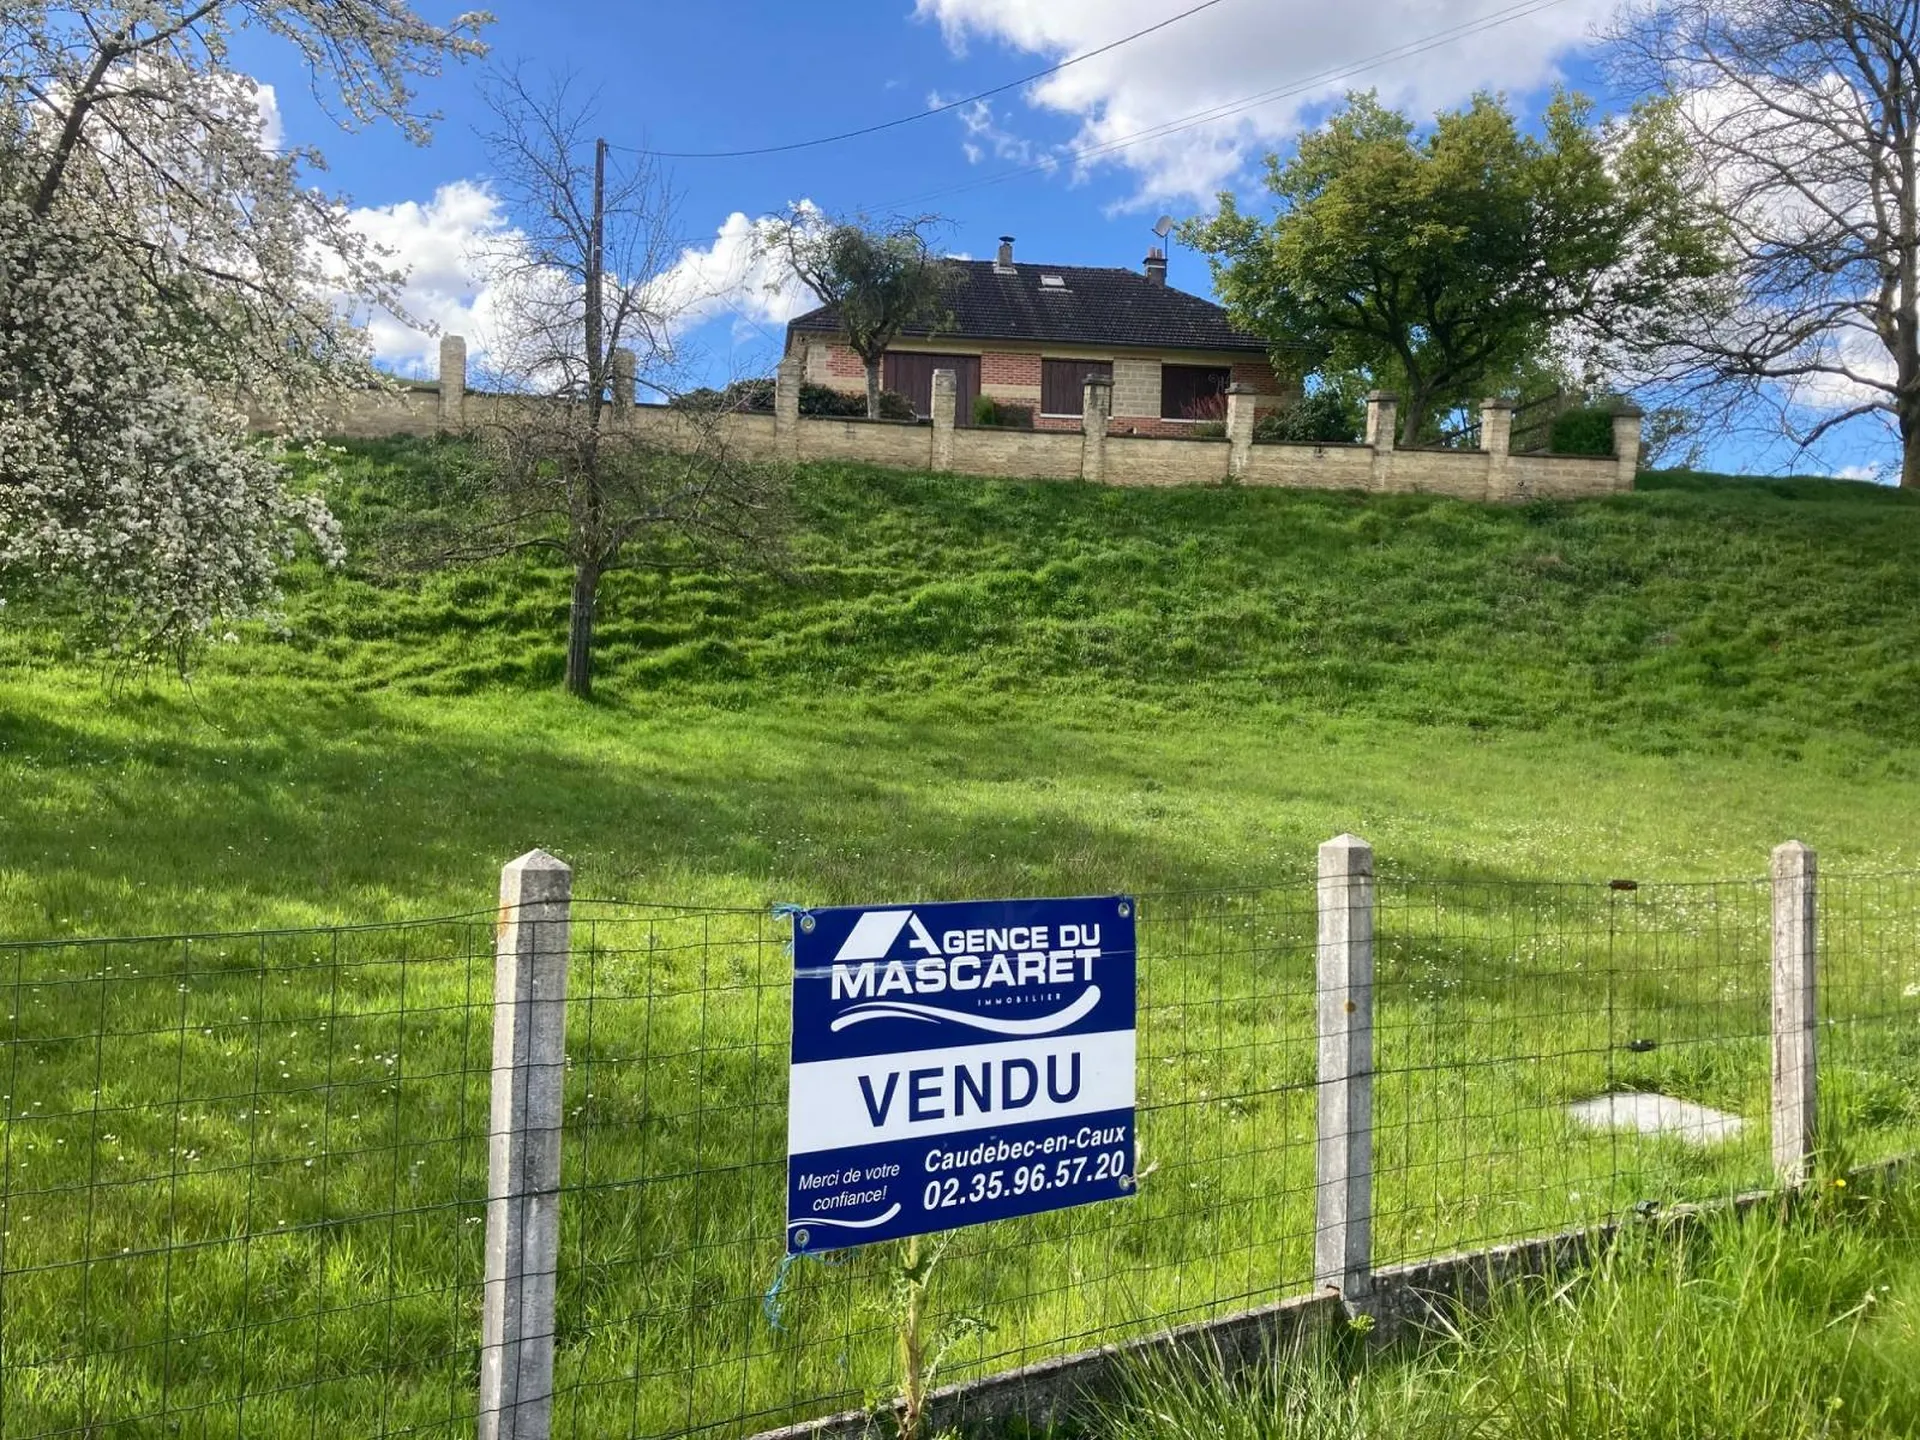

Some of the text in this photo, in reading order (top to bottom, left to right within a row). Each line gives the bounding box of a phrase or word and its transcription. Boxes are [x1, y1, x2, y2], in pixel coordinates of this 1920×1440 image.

[886, 912, 1100, 955] AGENCE DU
[831, 948, 1101, 1000] MASCARET
[977, 993, 1062, 1006] IMMOBILIER
[858, 1052, 1081, 1127] VENDU
[925, 1125, 1126, 1172] Caudebec-en-Caux
[798, 1163, 900, 1191] Merci de votre
[812, 1186, 887, 1212] confiance!
[923, 1150, 1125, 1211] 02.35.96.57.20
